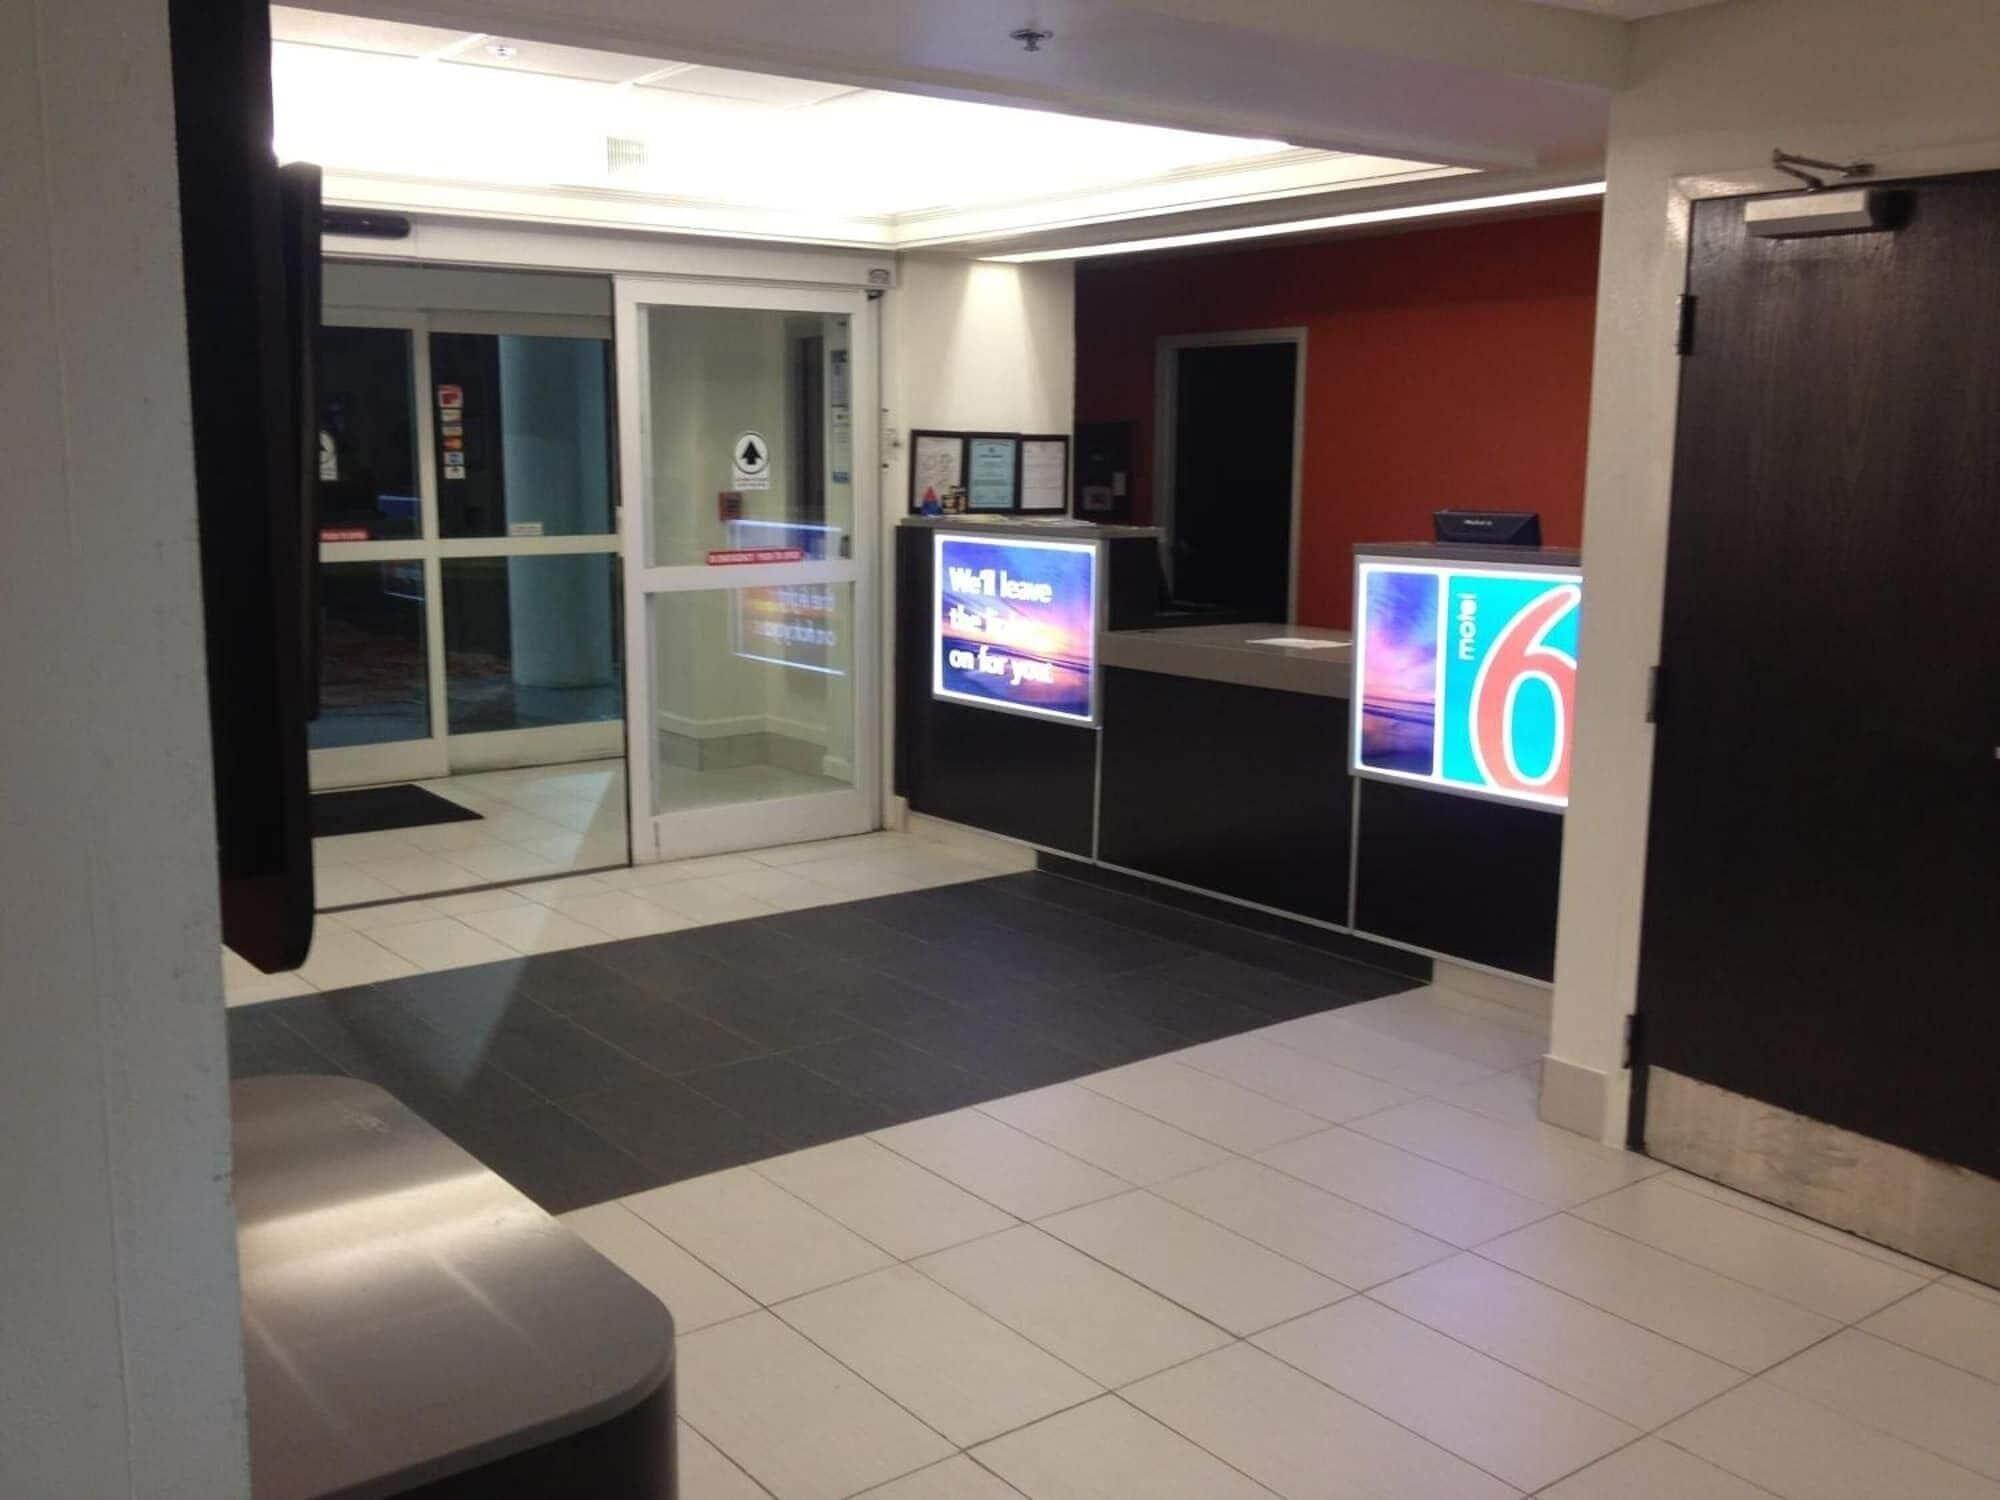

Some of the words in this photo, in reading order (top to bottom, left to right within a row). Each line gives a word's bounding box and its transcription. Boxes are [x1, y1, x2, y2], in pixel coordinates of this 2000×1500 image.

[948, 566, 996, 597] We'll
[1000, 569, 1053, 603] leave
[949, 603, 983, 632] the
[1458, 593, 1477, 660] motel
[948, 649, 975, 670] on
[978, 645, 1007, 675] for
[1469, 583, 1581, 798] 6
